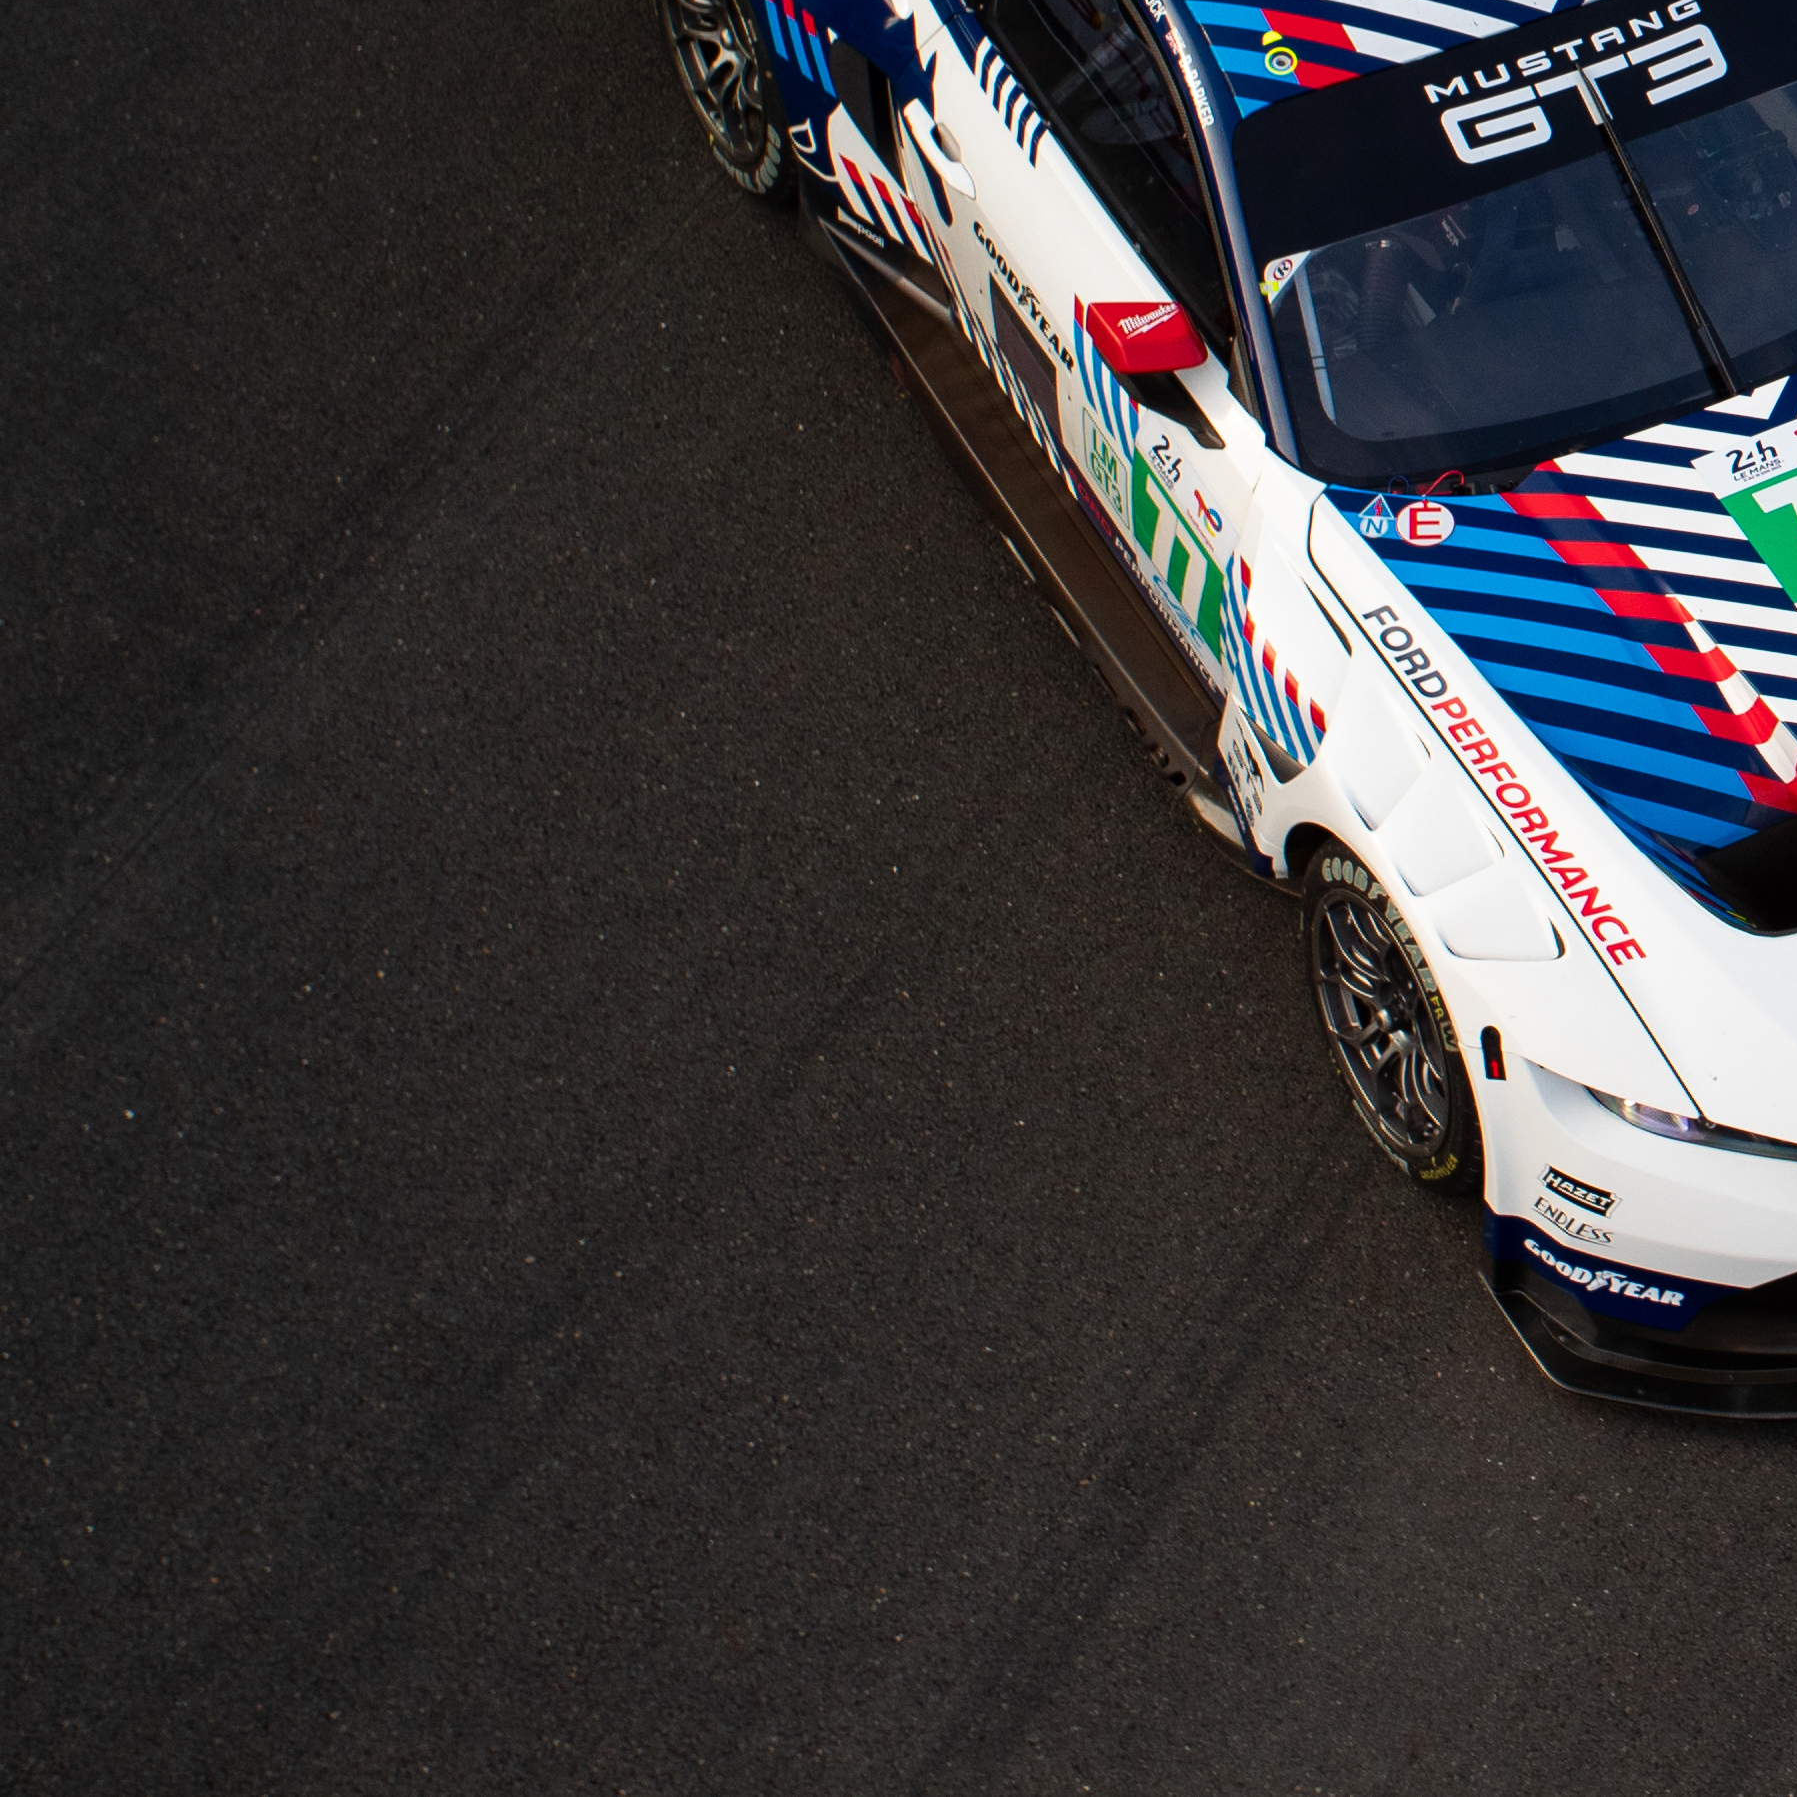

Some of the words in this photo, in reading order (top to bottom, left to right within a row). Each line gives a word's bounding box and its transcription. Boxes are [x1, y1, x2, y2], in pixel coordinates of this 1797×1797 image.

[1441, 23, 1727, 165] GT3
[973, 221, 1075, 373] GOODYEAR
[1117, 303, 1178, 335] Milwaukee
[1093, 428, 1118, 484] LM
[1152, 434, 1182, 483] 24h
[1726, 439, 1779, 474] 24h
[1733, 471, 1749, 482] LE
[1091, 453, 1123, 514] GT3
[1365, 518, 1385, 536] N
[1409, 506, 1443, 540] E
[1145, 472, 1208, 627] 77
[1546, 1171, 1616, 1209] HAZET
[1534, 1196, 1612, 1245] ENDLESS
[1524, 1238, 1685, 1307] GOODYEAR
